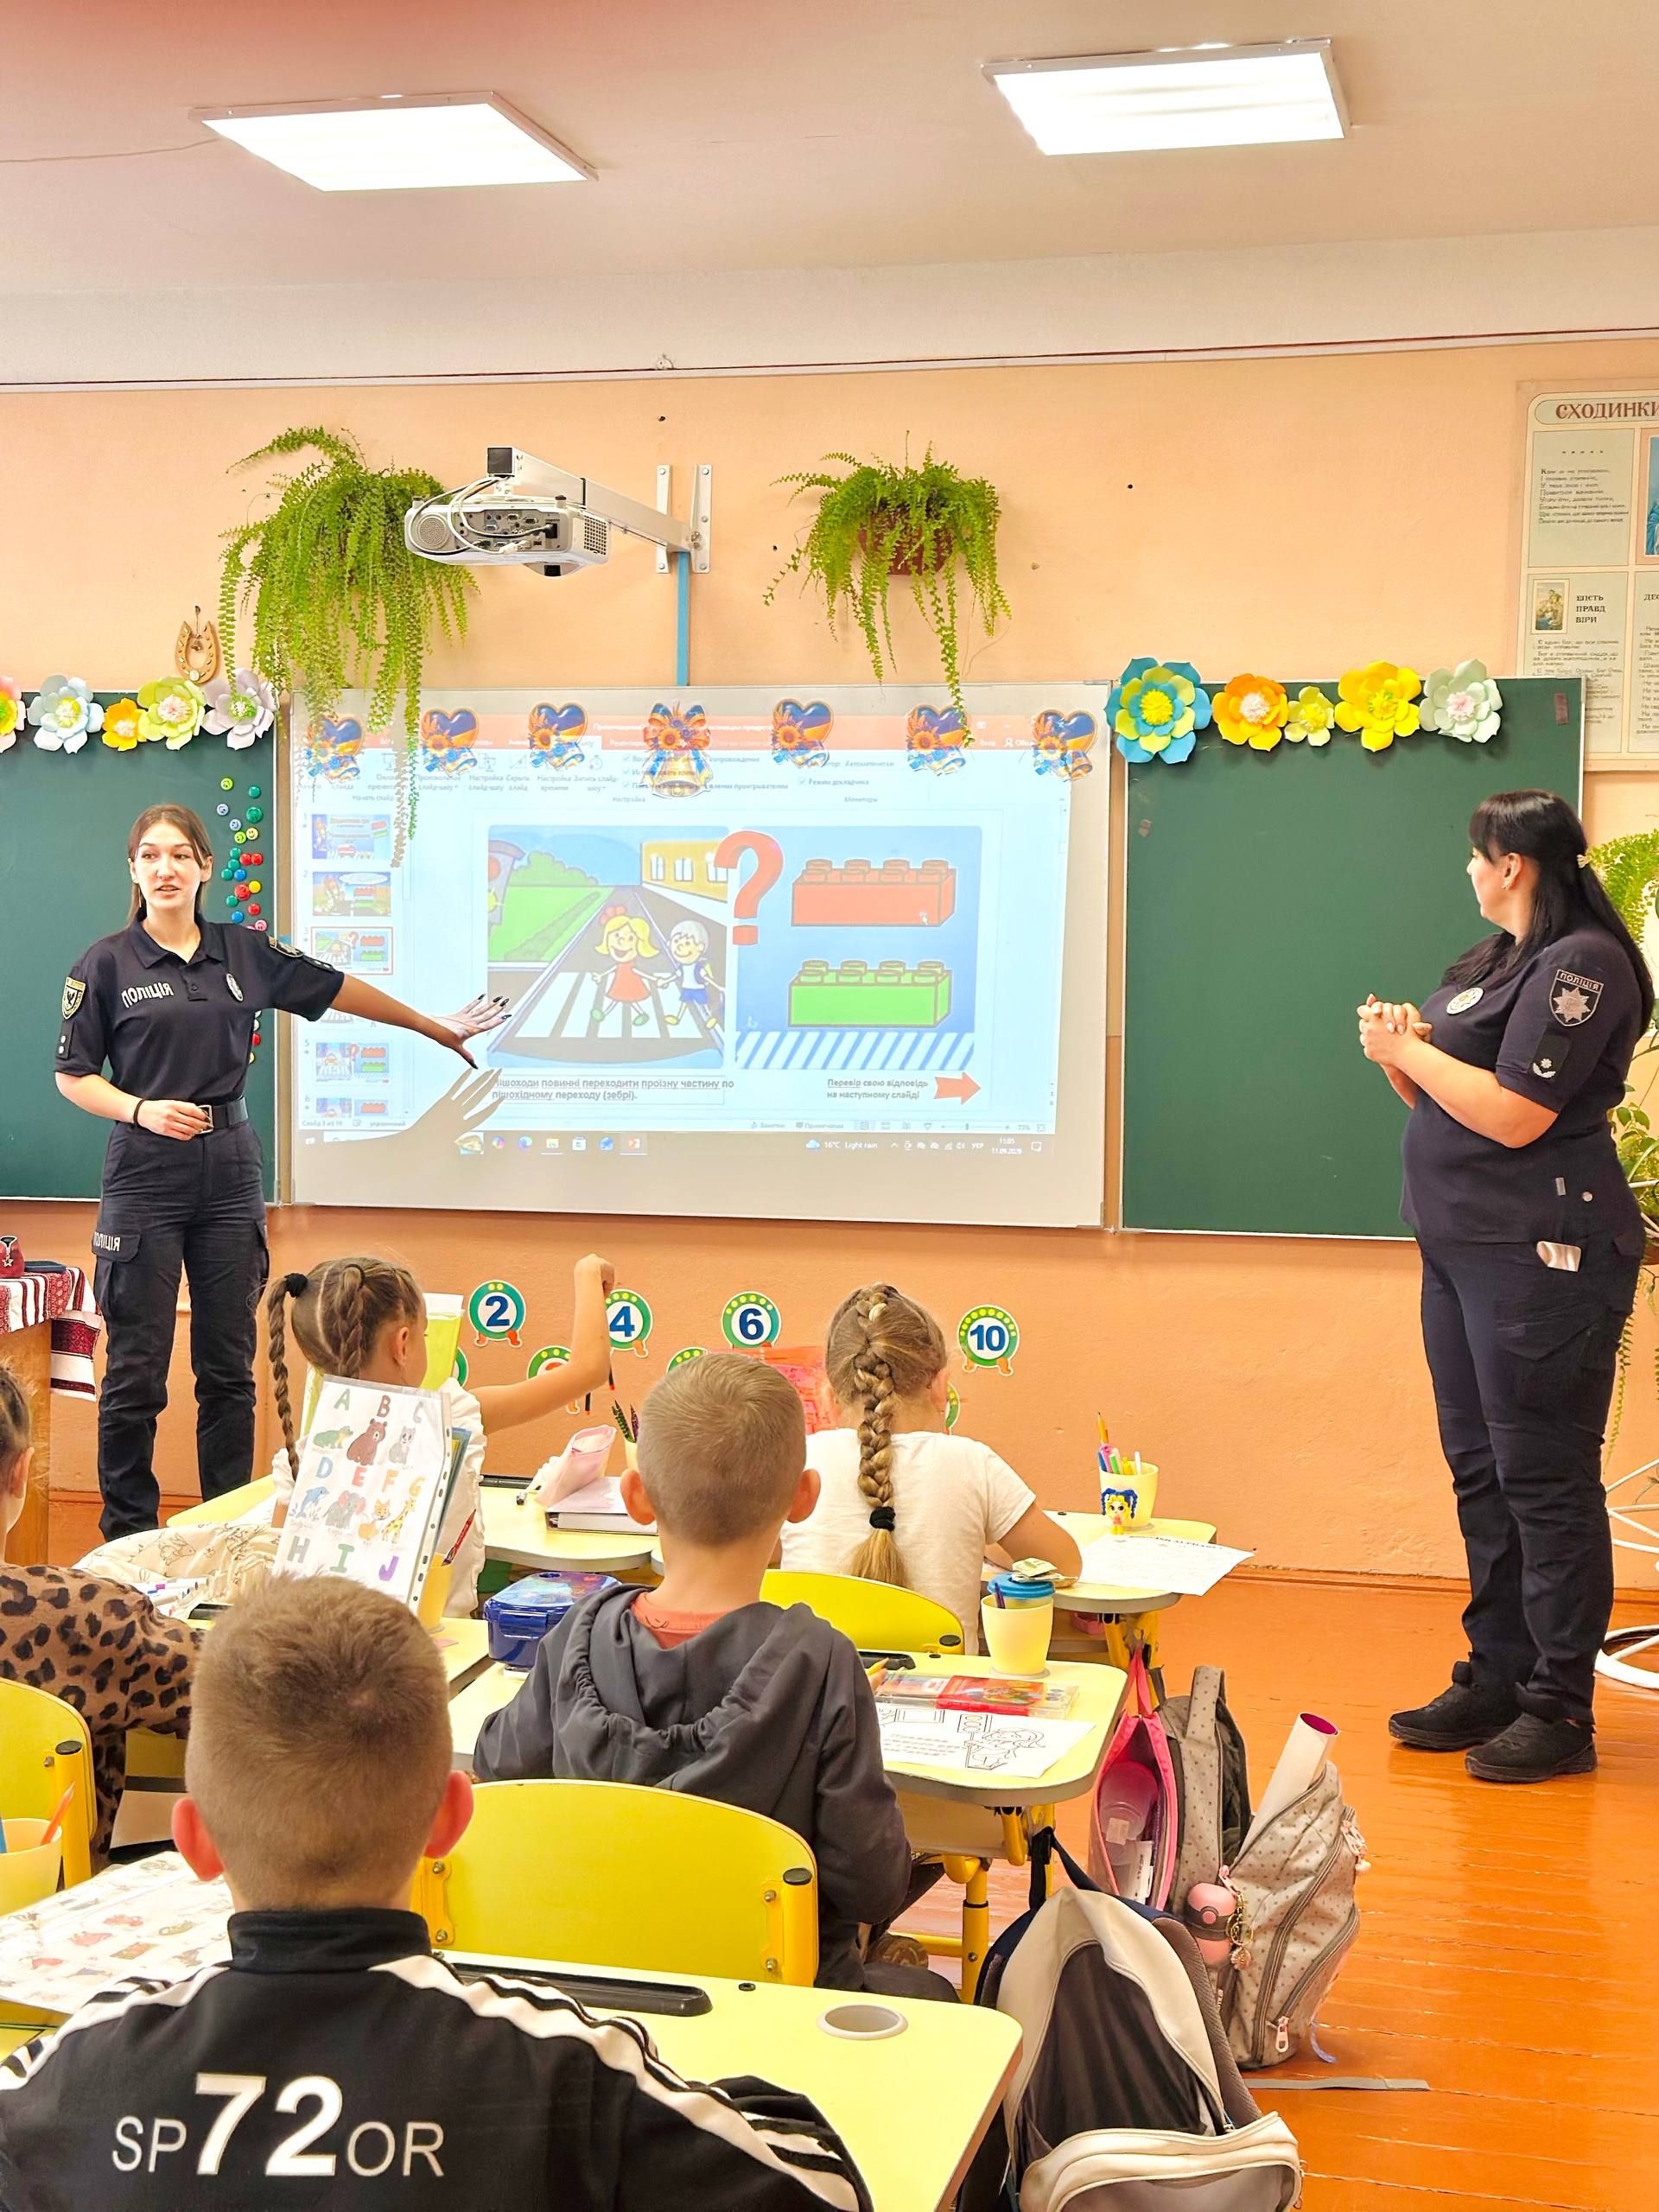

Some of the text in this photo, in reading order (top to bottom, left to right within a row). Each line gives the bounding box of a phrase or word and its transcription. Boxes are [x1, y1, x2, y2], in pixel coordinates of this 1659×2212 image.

[121, 982, 175, 1008] ПОЛІЦІЯ
[1560, 972, 1599, 991] ПОЛІЦІЯ
[541, 1078, 580, 1088] повинні
[582, 1079, 639, 1090] переходити
[681, 1080, 720, 1090] частину
[555, 1090, 601, 1101] переходу
[603, 1090, 639, 1101] (зебрі).
[828, 1078, 861, 1087] Перевір
[486, 1295, 511, 1327] 2
[609, 1306, 635, 1338] 4
[739, 1307, 765, 1340] 6
[969, 1325, 1006, 1351] 10
[334, 1388, 351, 1411] A
[376, 1395, 391, 1419] B
[315, 1457, 426, 1498] D E F G
[287, 1535, 399, 1581] H I J
